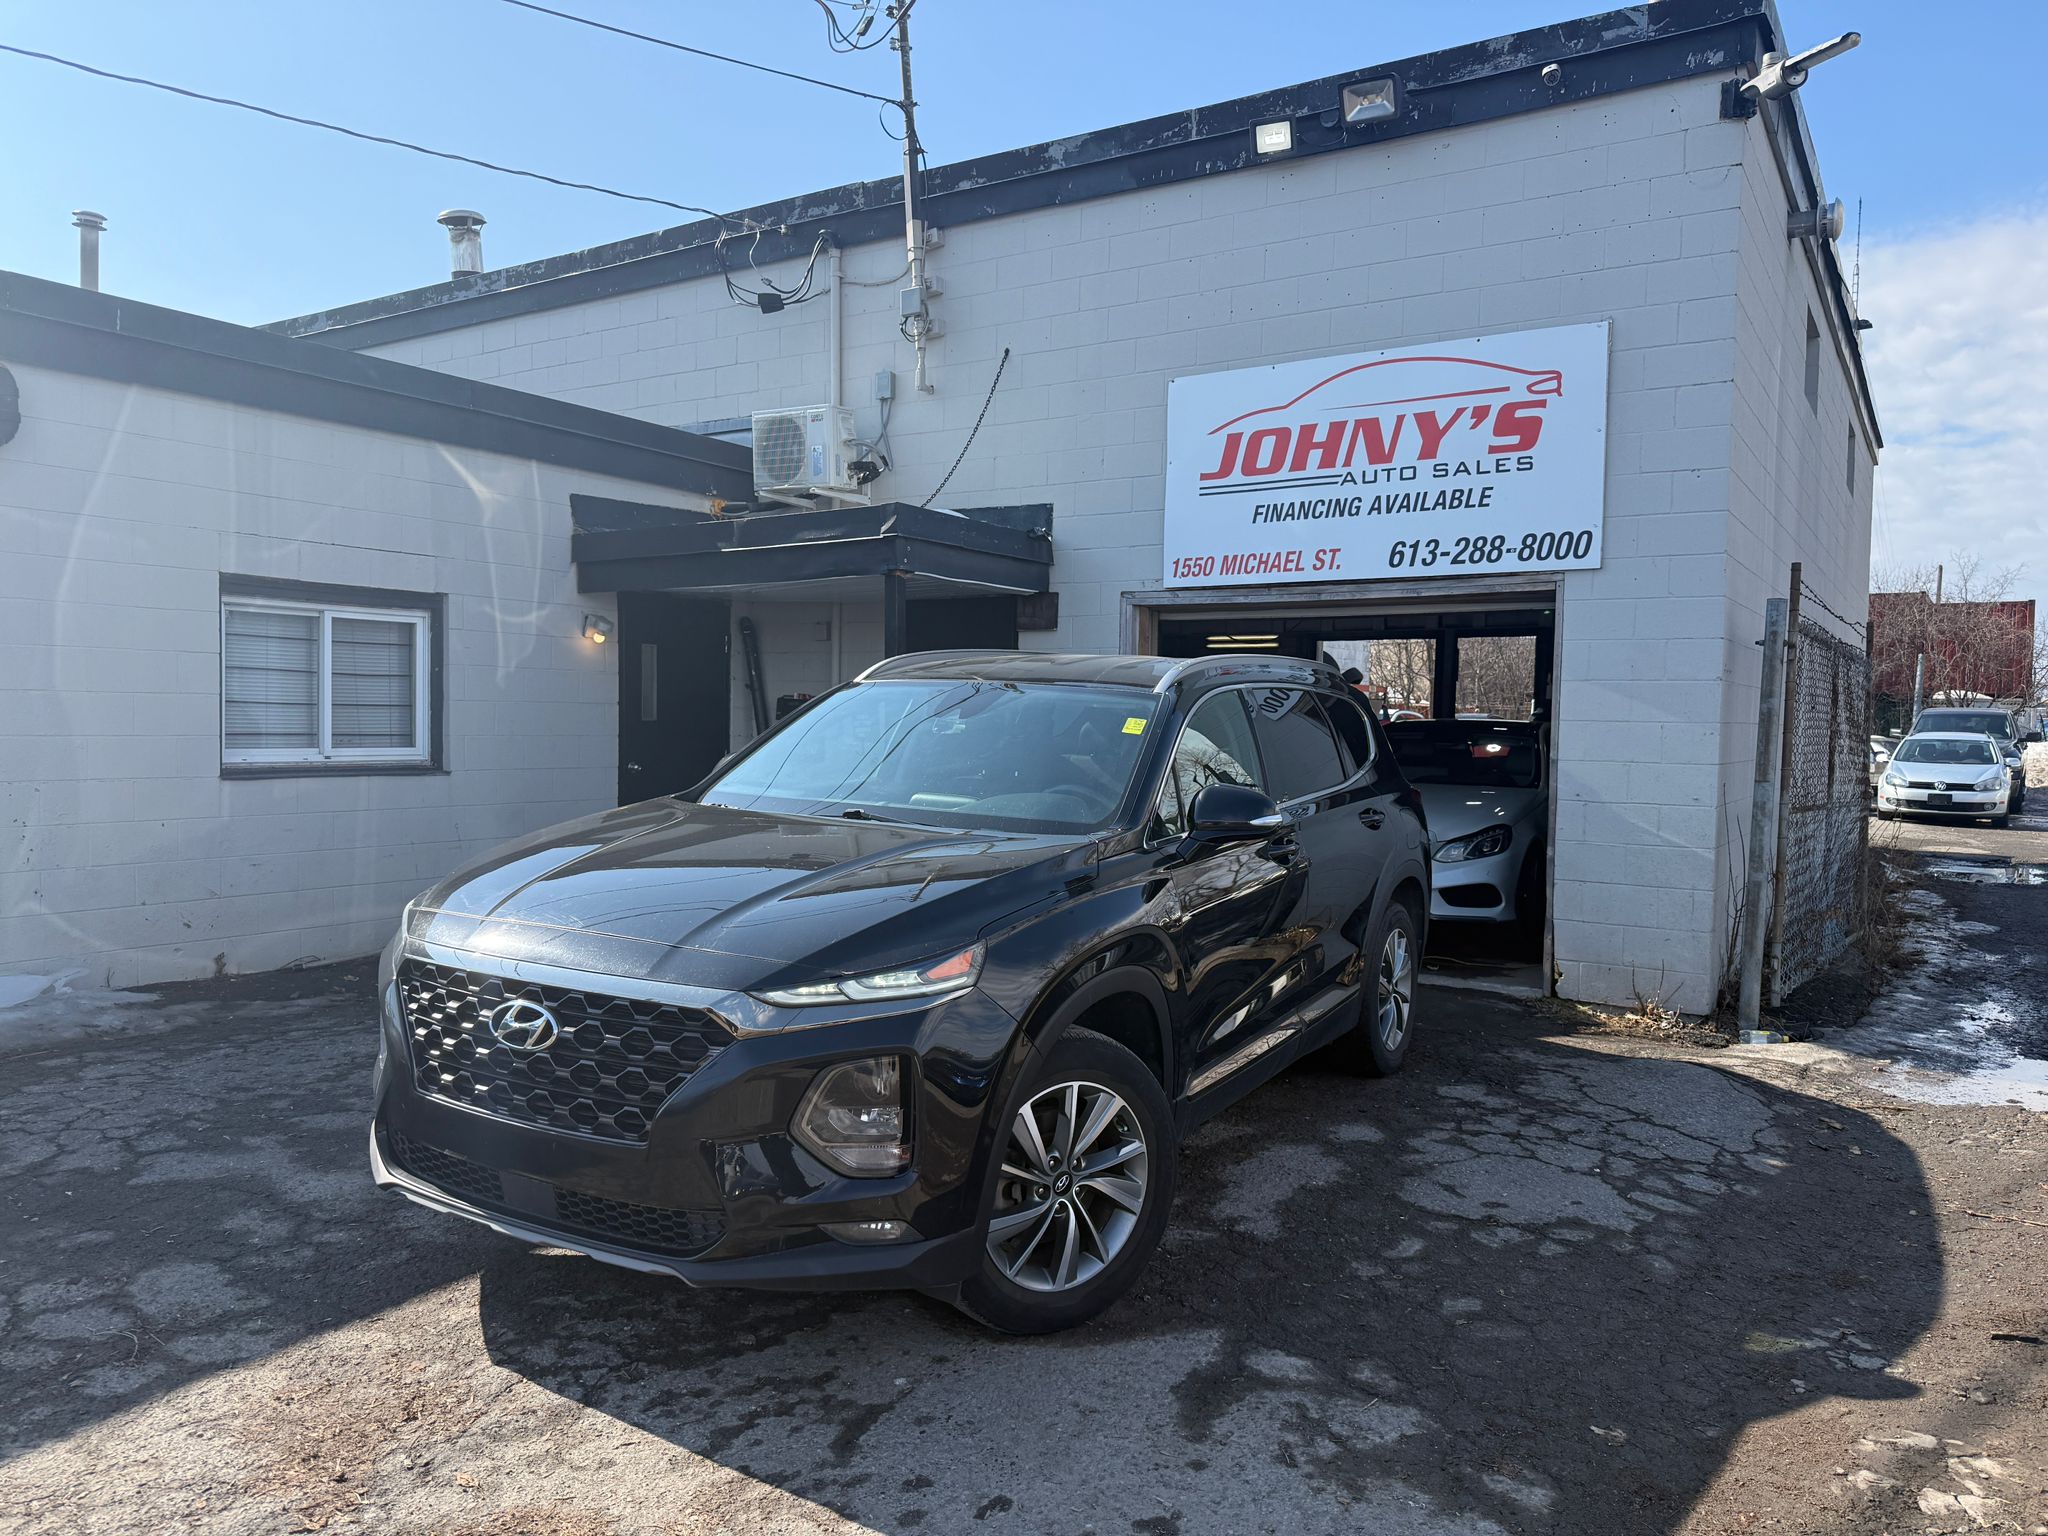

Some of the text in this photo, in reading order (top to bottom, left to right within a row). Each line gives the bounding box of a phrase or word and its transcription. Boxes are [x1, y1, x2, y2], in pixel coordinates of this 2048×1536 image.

[1199, 398, 1548, 481] JOHNY'S
[1340, 455, 1534, 487] AUTO SALES
[1252, 486, 1495, 525] FINANCING AVAILABLE
[1171, 548, 1342, 579] 1550 MICHAEL ST.
[1388, 530, 1594, 569] 613-288-8000
